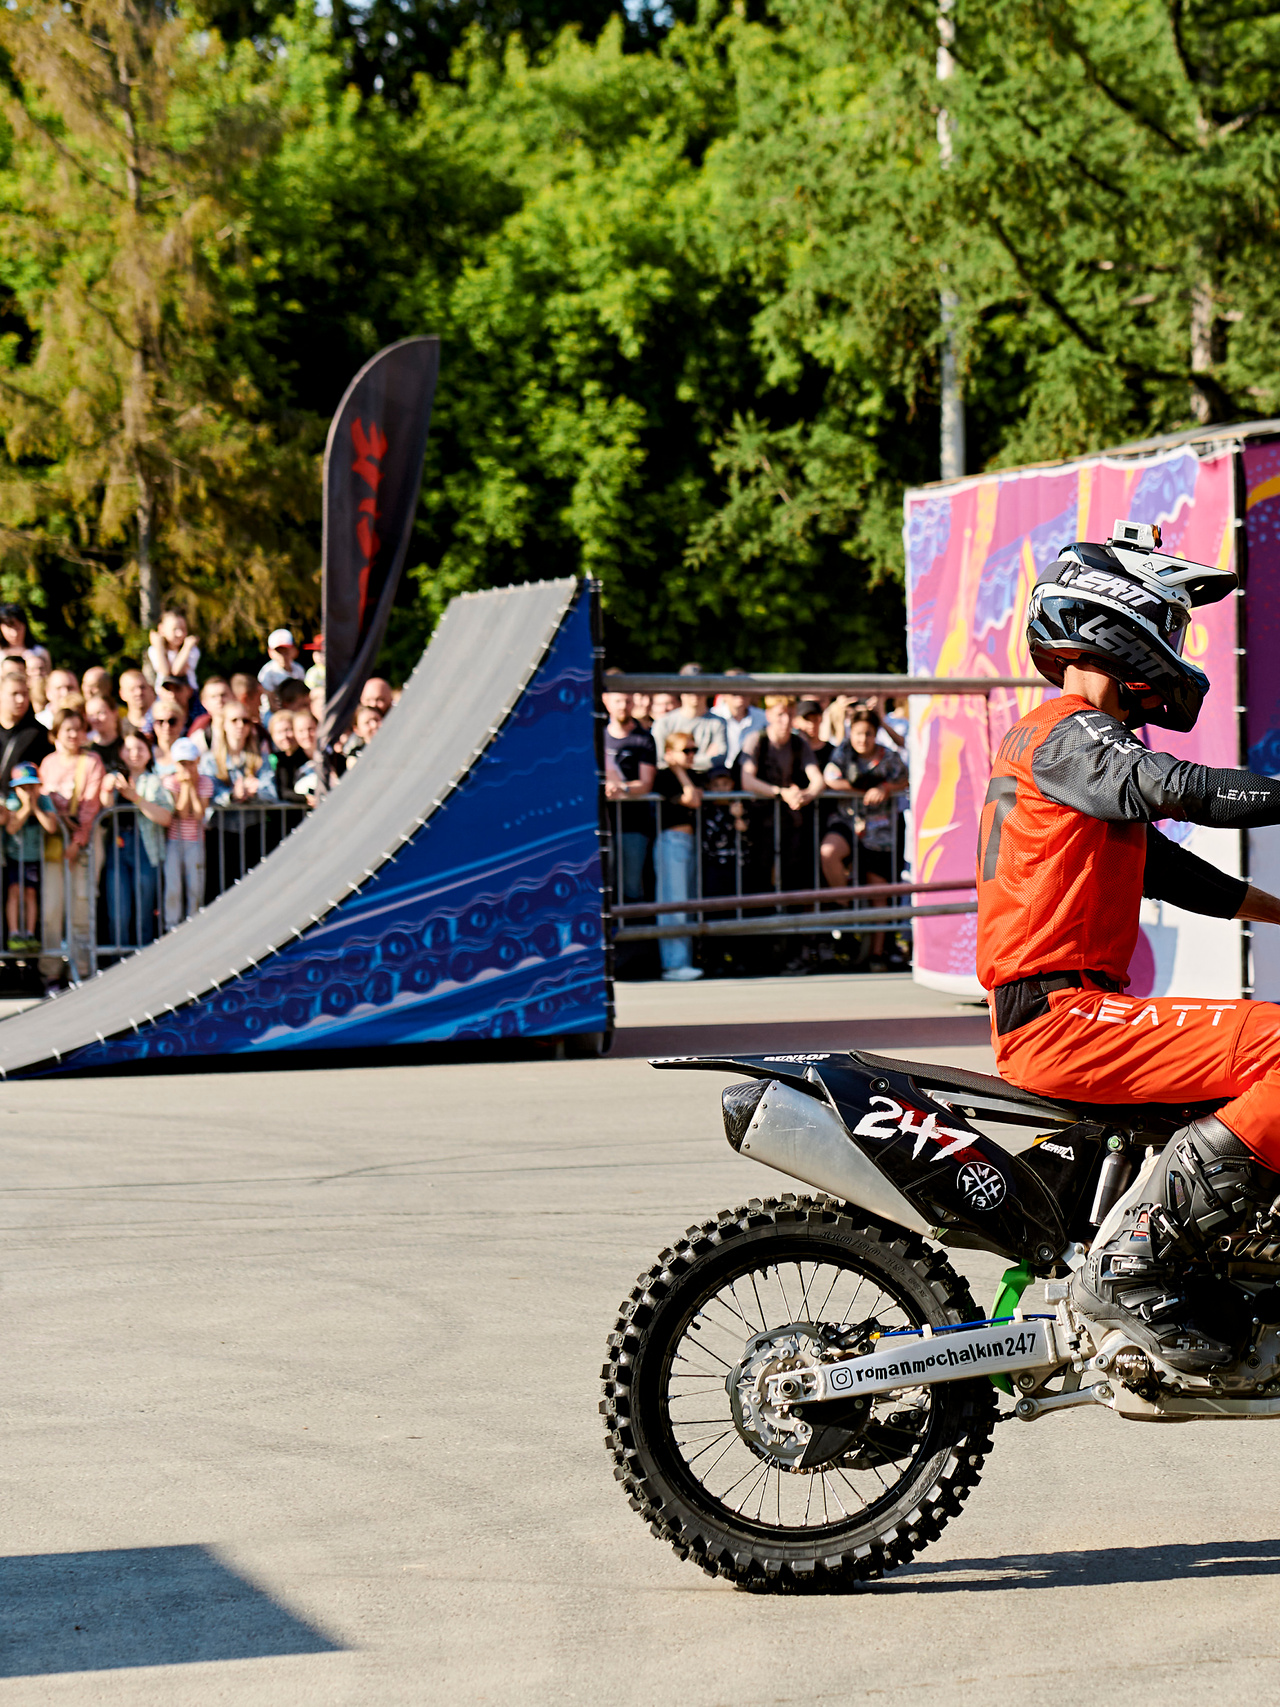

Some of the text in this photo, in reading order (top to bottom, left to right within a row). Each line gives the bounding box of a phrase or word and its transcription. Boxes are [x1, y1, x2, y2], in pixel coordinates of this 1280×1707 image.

[1079, 614, 1180, 679] LEATT
[1217, 786, 1271, 802] LEATT
[852, 1095, 980, 1162] 247
[856, 1332, 1036, 1382] romanmochalkin247
